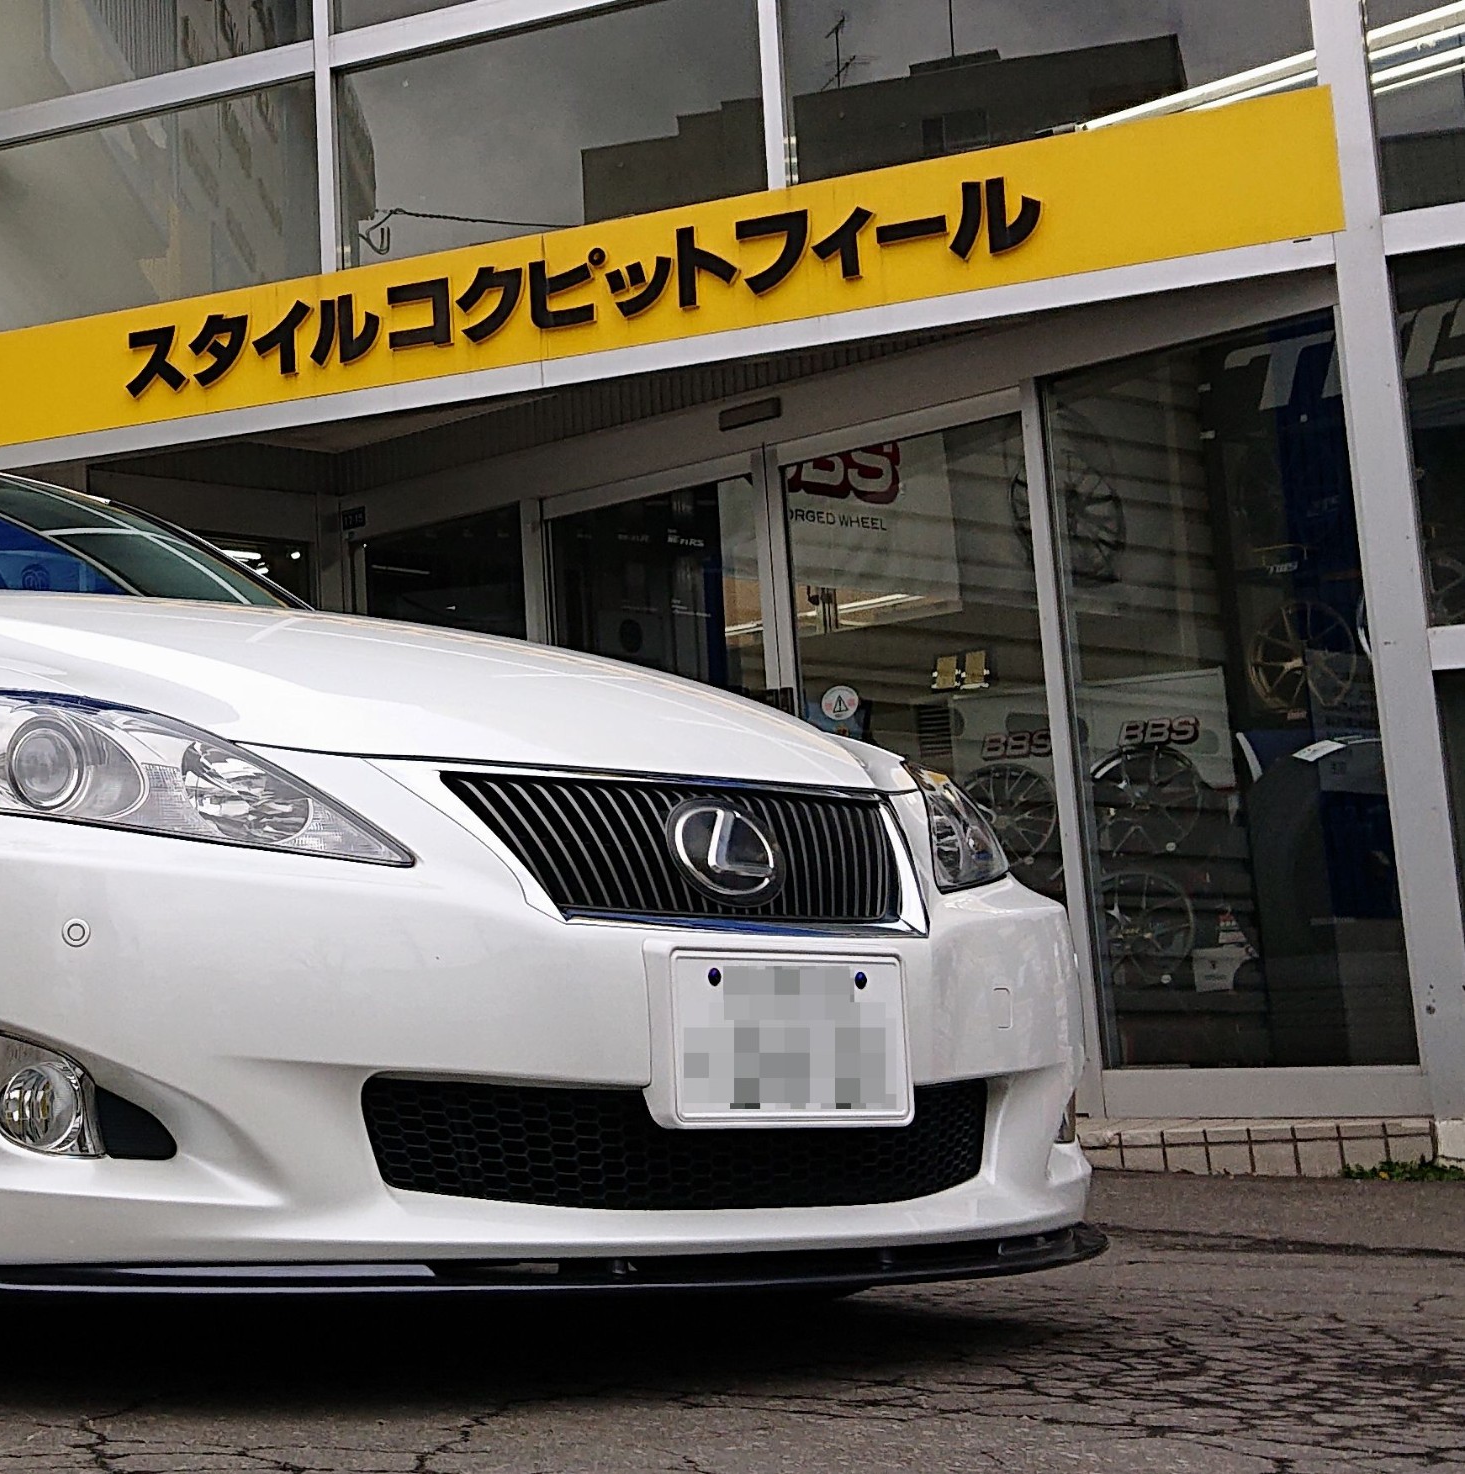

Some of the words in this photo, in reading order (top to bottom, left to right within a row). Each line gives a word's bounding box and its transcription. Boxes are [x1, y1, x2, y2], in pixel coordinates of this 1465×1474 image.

[125, 177, 1042, 396] スタイルコクピットフィール
[787, 441, 900, 504] BS
[838, 514, 887, 531] WHEEL
[982, 728, 1053, 761] BBS
[1117, 715, 1199, 748] BBS
